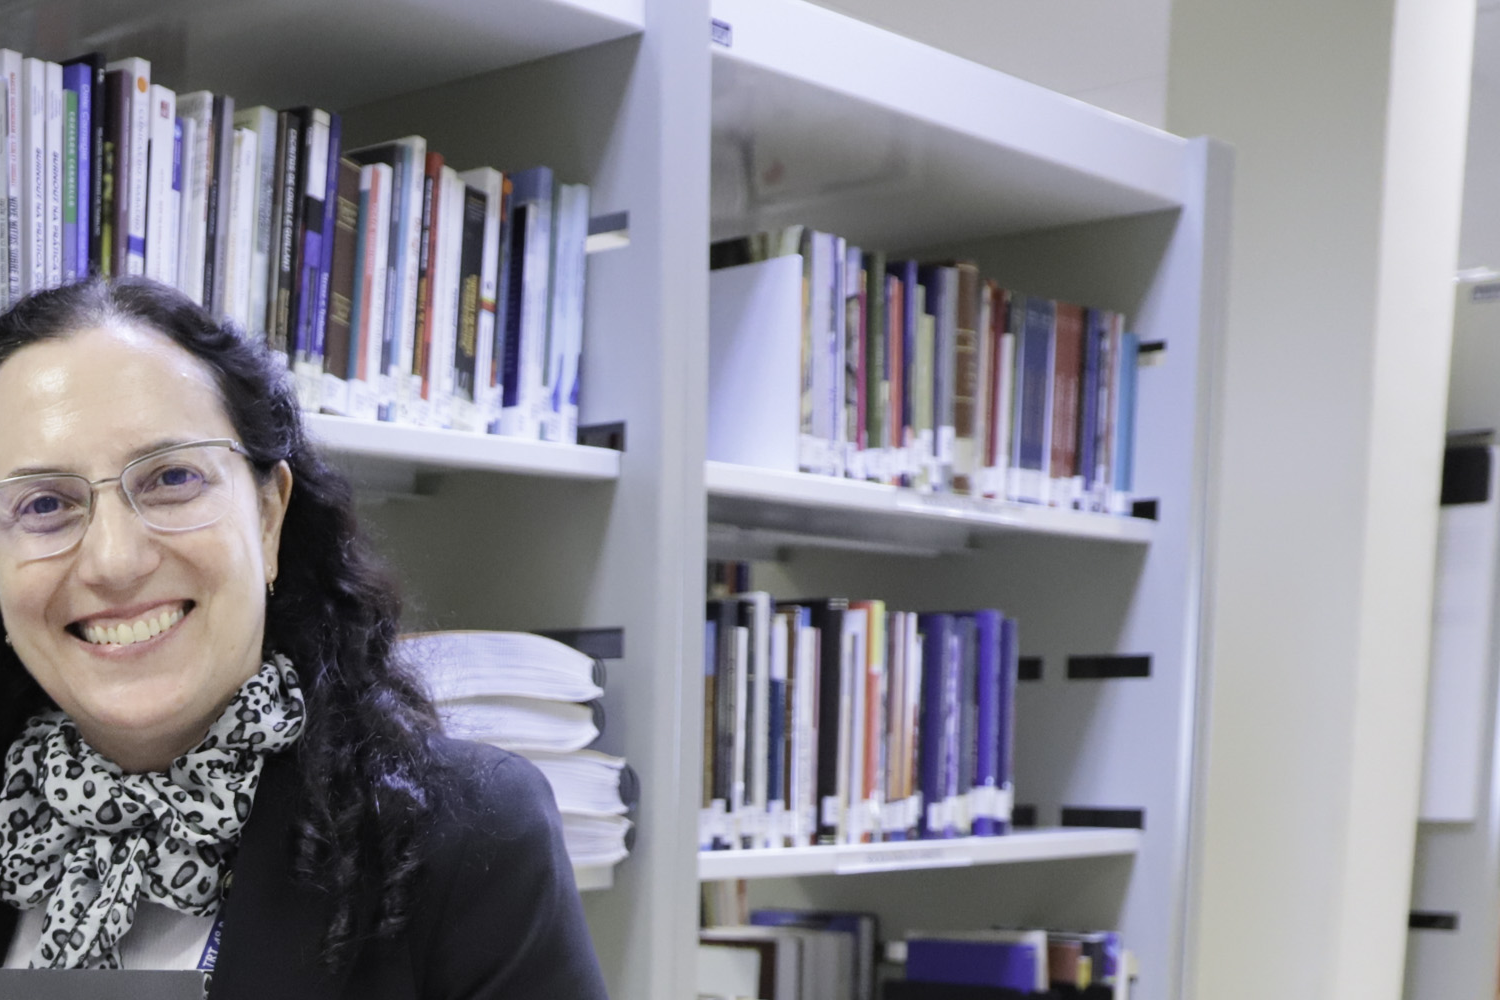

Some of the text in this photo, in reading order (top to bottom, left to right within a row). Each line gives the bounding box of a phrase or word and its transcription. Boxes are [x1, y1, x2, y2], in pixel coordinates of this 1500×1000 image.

[286, 128, 299, 171] ESCRITOS
[286, 172, 296, 184] DE
[34, 147, 45, 267] BURNOUT NA PRÁTICA
[51, 151, 61, 271] BURNOUT NA PRÁTICA
[284, 186, 295, 213] LOUIS
[284, 214, 293, 225] LE
[203, 946, 219, 967] TRT
